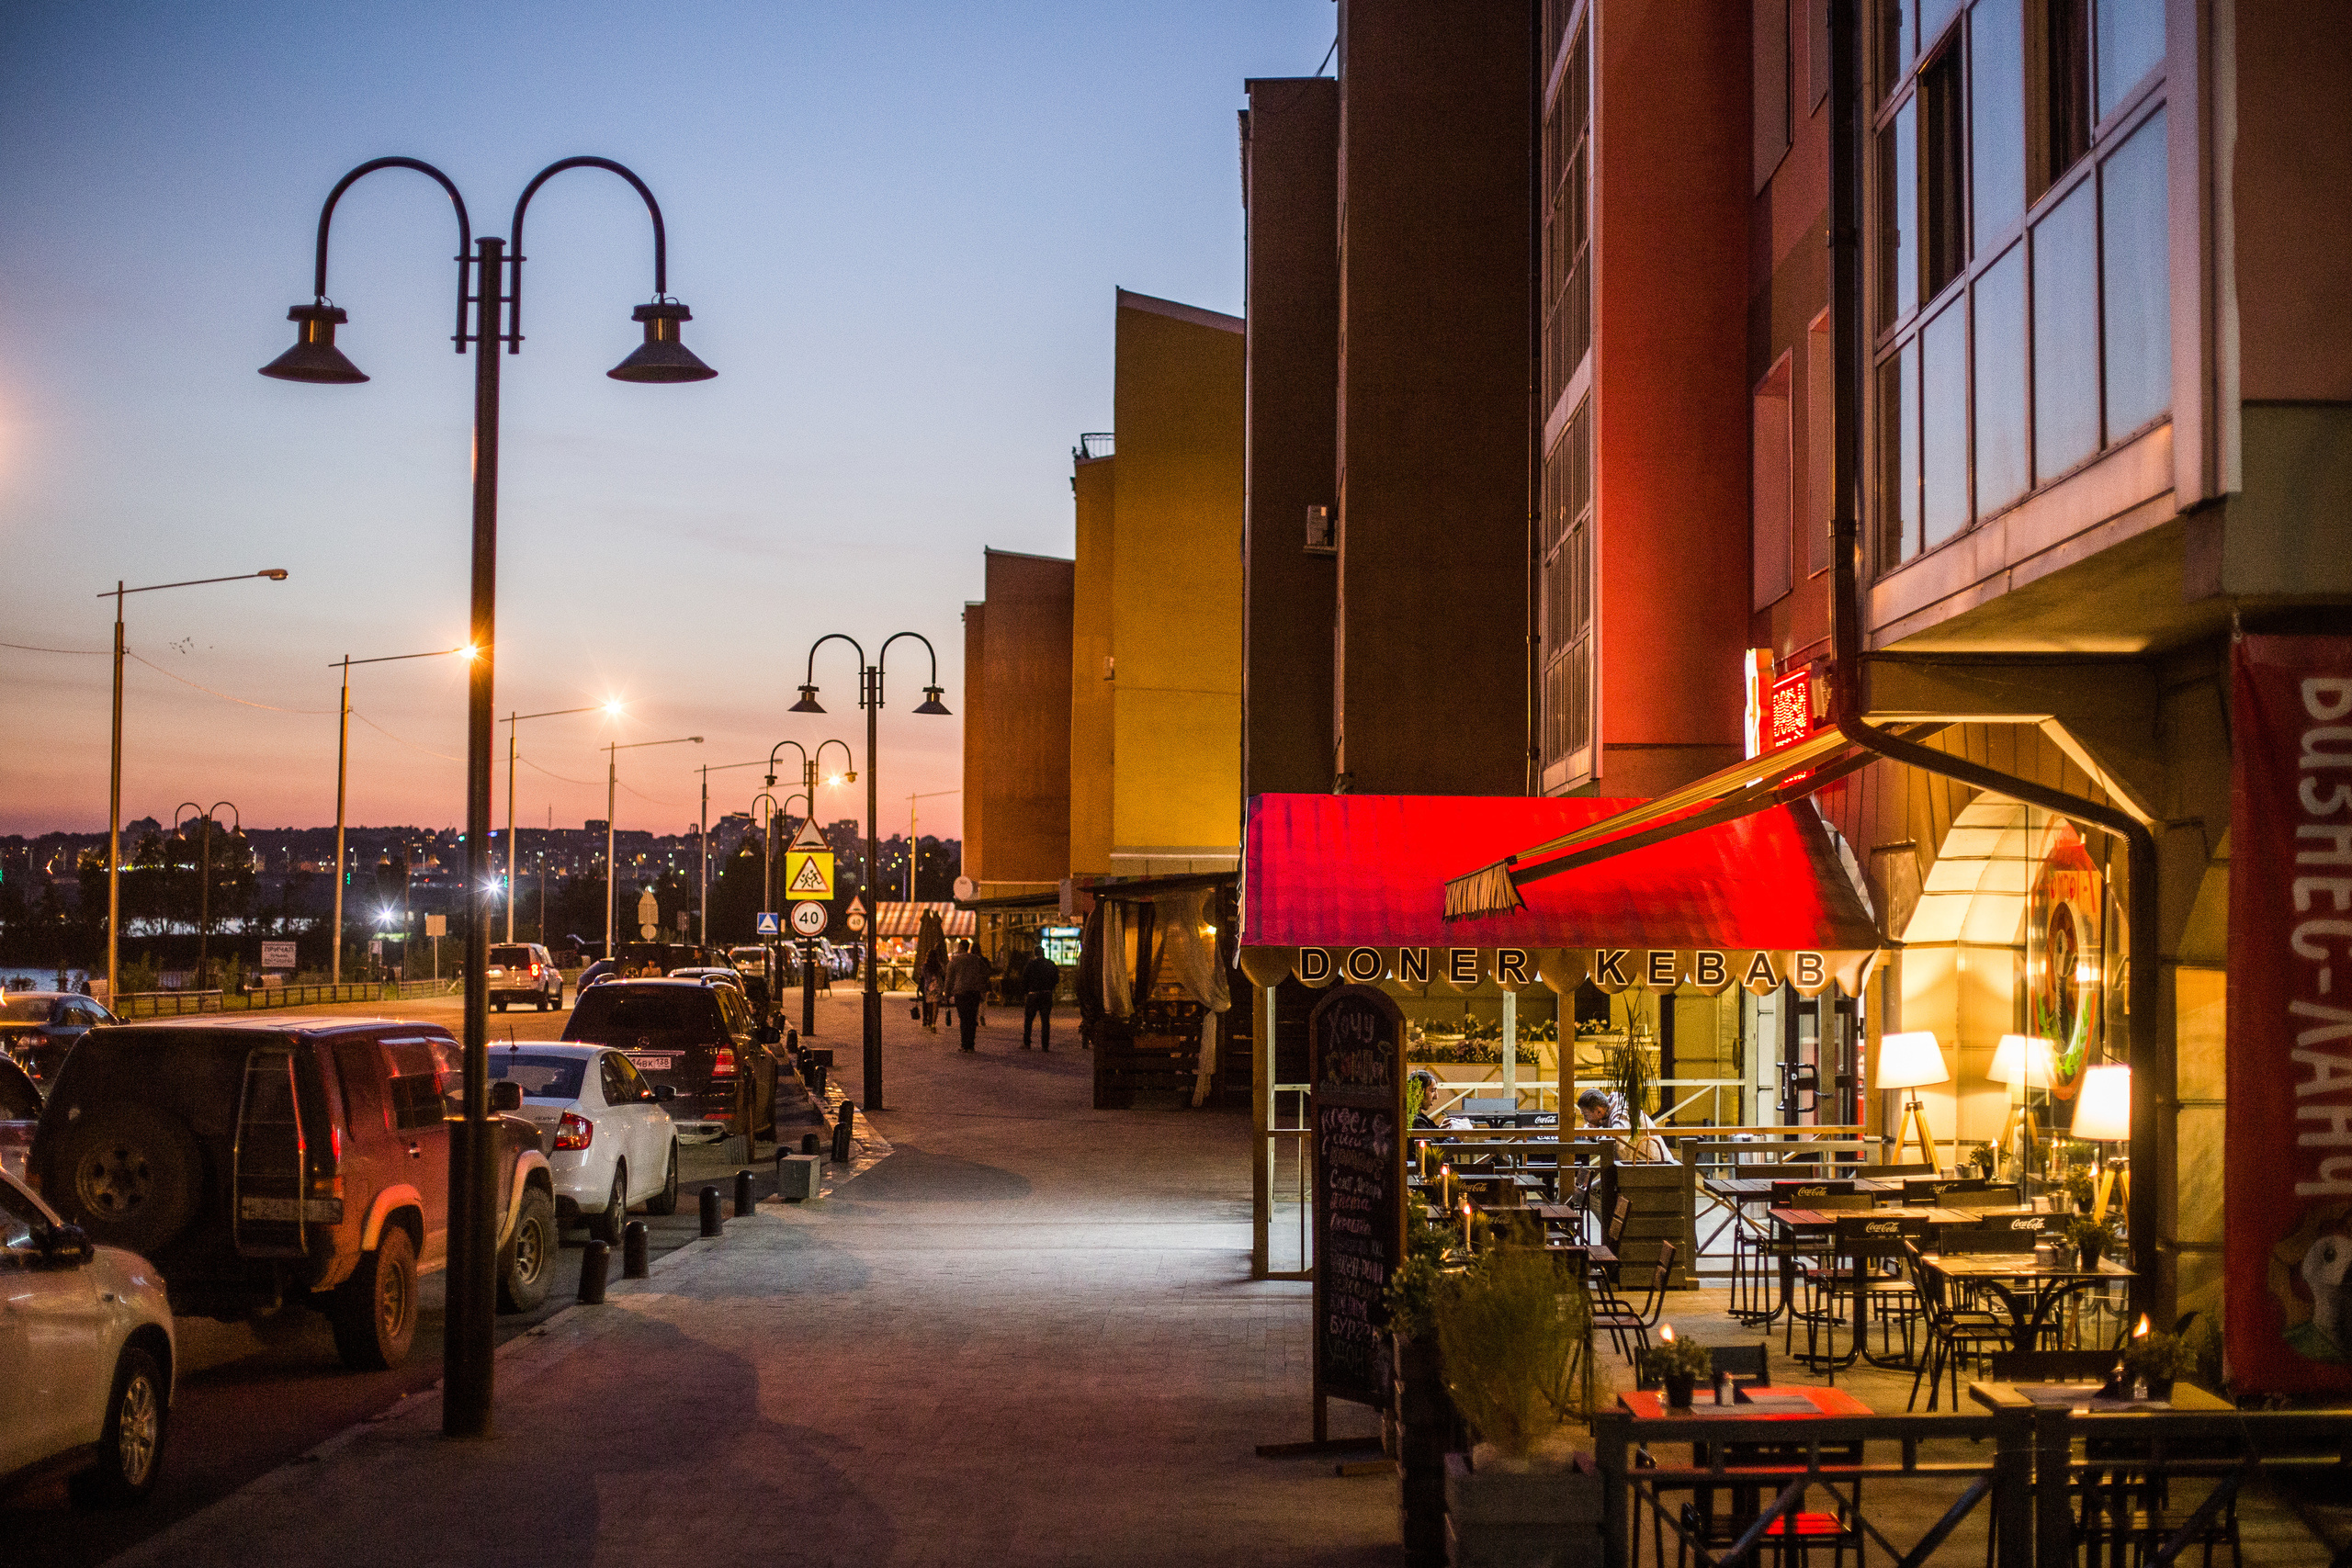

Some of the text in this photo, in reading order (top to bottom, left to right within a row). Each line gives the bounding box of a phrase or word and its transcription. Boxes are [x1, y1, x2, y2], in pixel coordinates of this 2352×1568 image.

[798, 911, 819, 925] 40
[1299, 946, 1826, 988] DONER KEBAB
[1797, 1186, 1827, 1197] Coca-Cola
[1865, 1222, 1900, 1233] Coca-Cola
[2011, 1217, 2045, 1230] Coca-Cola
